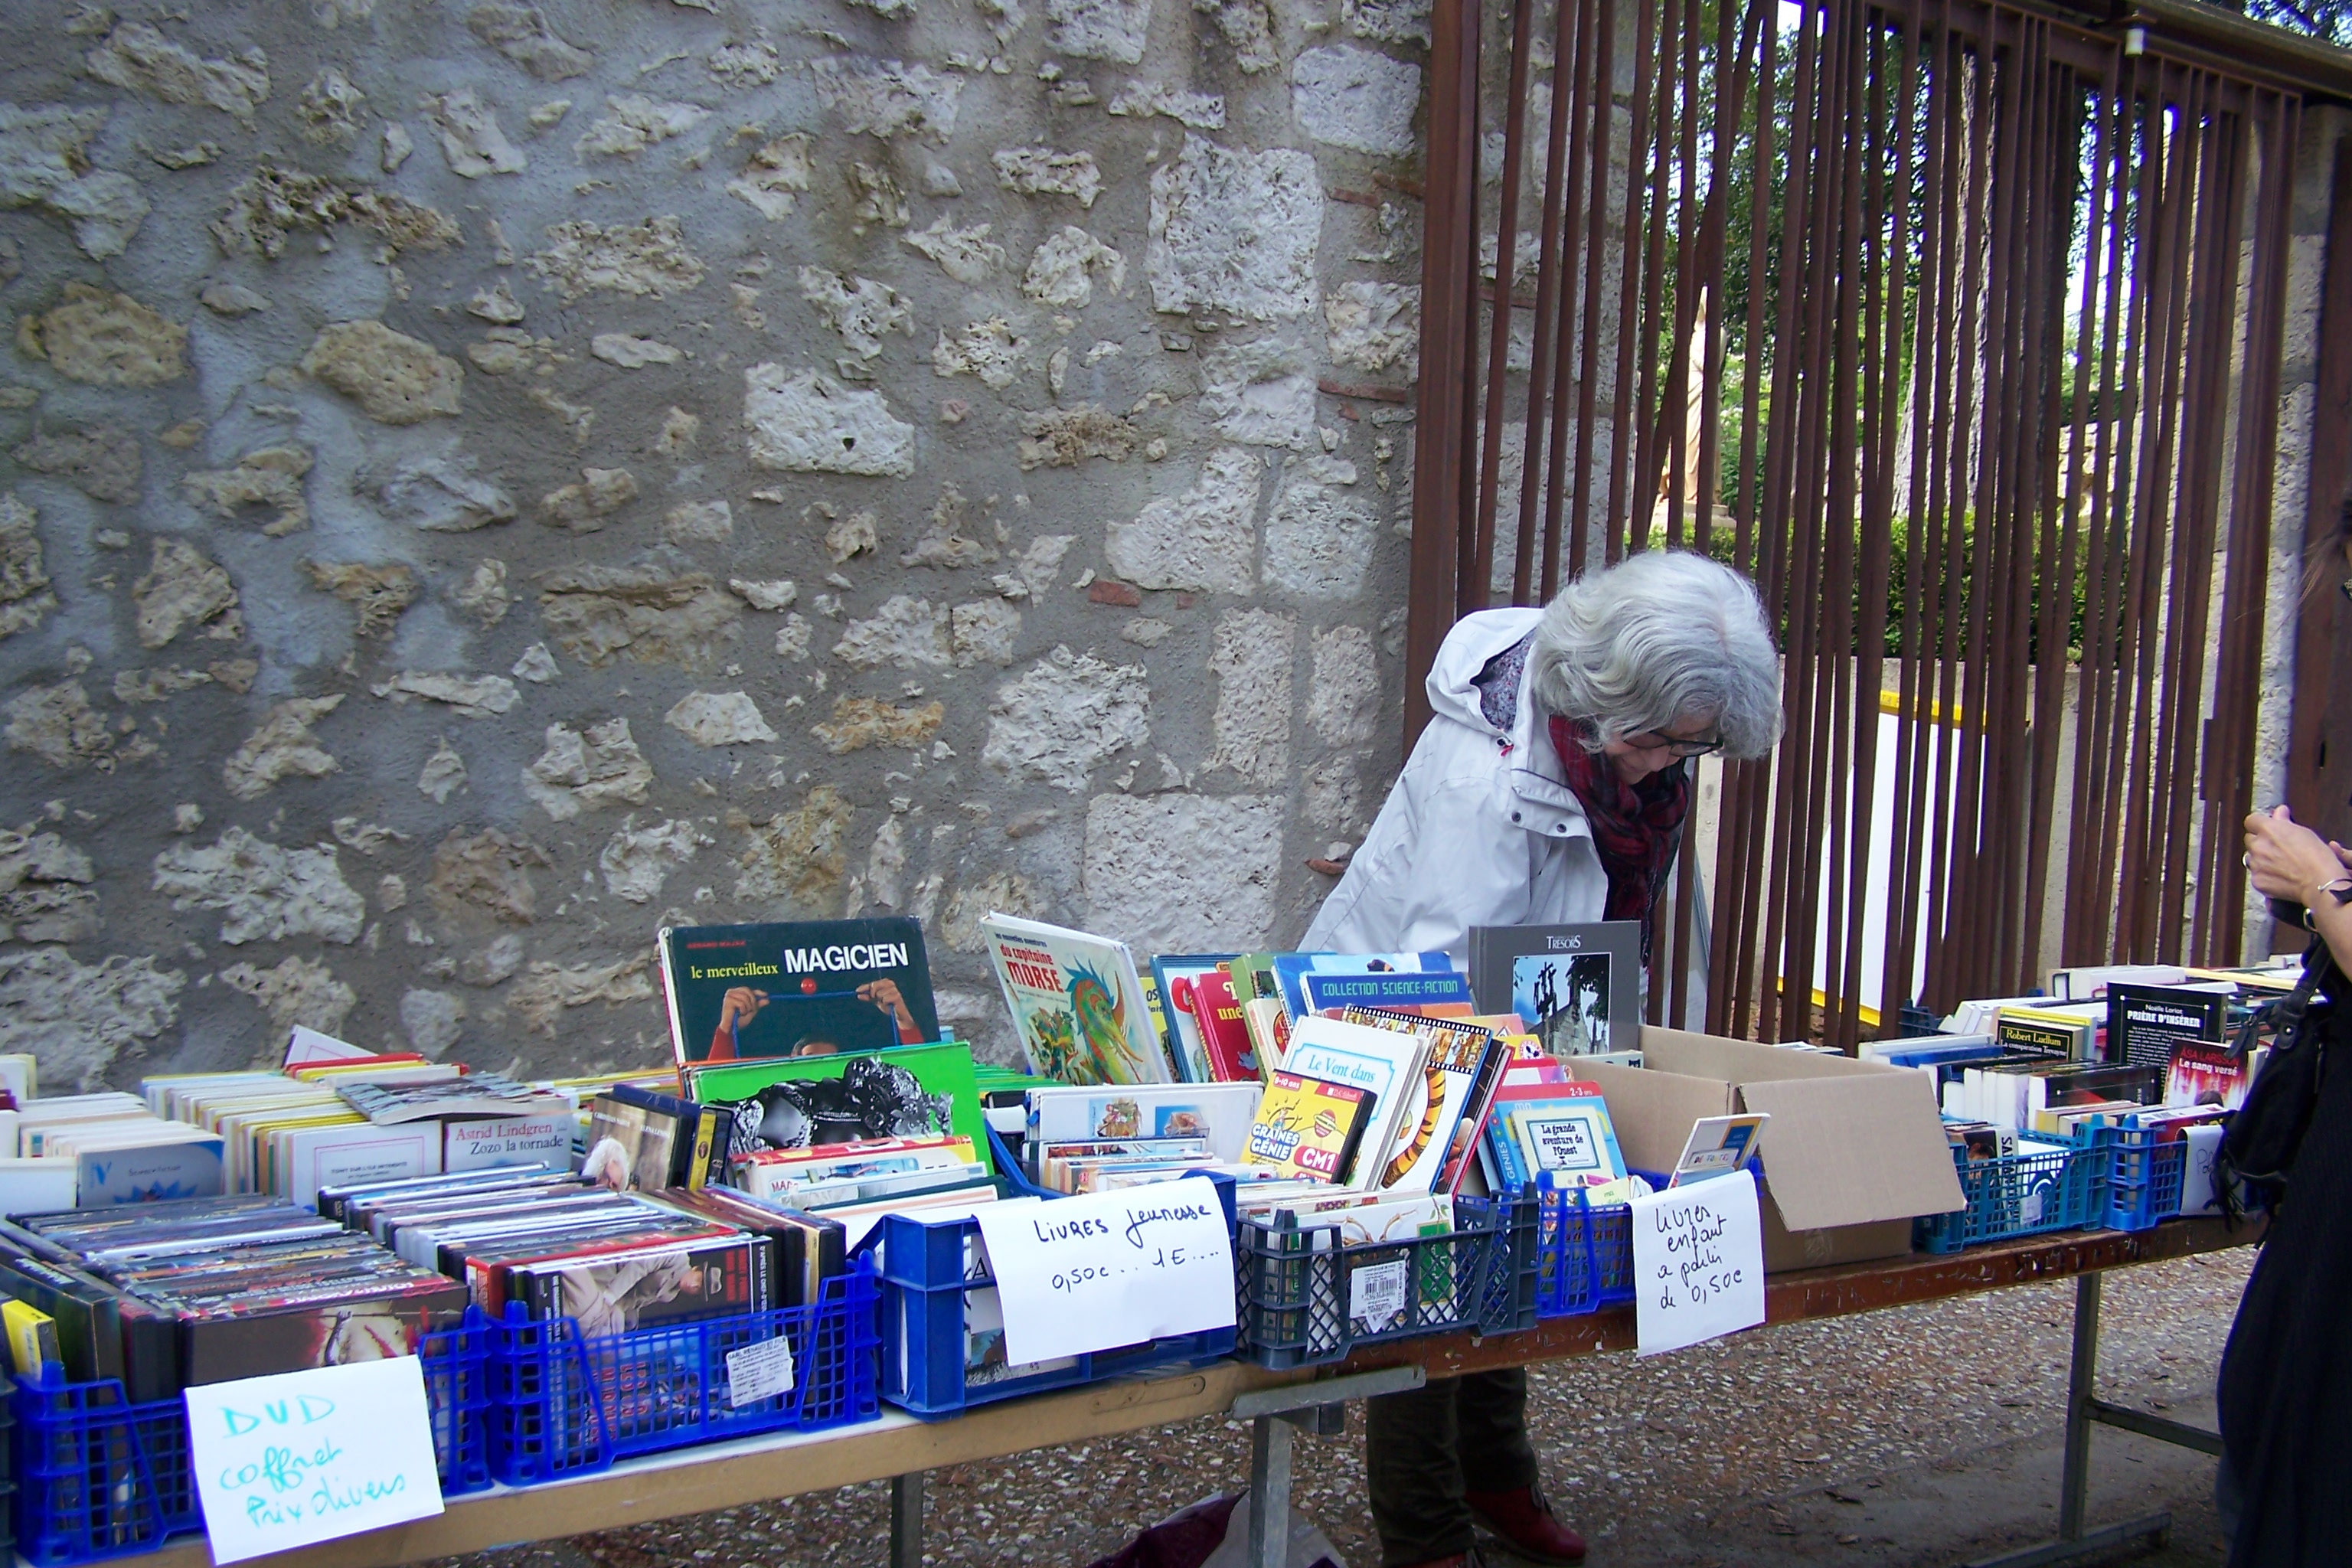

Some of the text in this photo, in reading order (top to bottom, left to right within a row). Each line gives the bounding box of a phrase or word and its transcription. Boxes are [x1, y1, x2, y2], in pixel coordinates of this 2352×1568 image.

[784, 942, 909, 973] MAGICIEN
[1000, 942, 1054, 965] du capitaine
[691, 962, 779, 978] le merveilleux
[1005, 960, 1064, 993] MORSE
[1322, 980, 1458, 996] COLLECTION SCIENCE-FICTION
[2006, 1029, 2061, 1046] Robert Ludlum
[1308, 1054, 1321, 1070] Le
[1324, 1057, 1348, 1076] Vent
[1351, 1064, 1376, 1082] dans
[2179, 1057, 2238, 1076] Le sang versé
[456, 1123, 552, 1141] Astrid Lindgren
[1540, 1123, 1576, 1135] La grande
[470, 1135, 564, 1155] Zozo la tornade
[1542, 1134, 1584, 1145] aventure de
[1302, 1148, 1336, 1171] CM1
[1553, 1146, 1577, 1156] l'Ouest
[1660, 1285, 1677, 1309] de
[312, 1475, 405, 1517] divers
